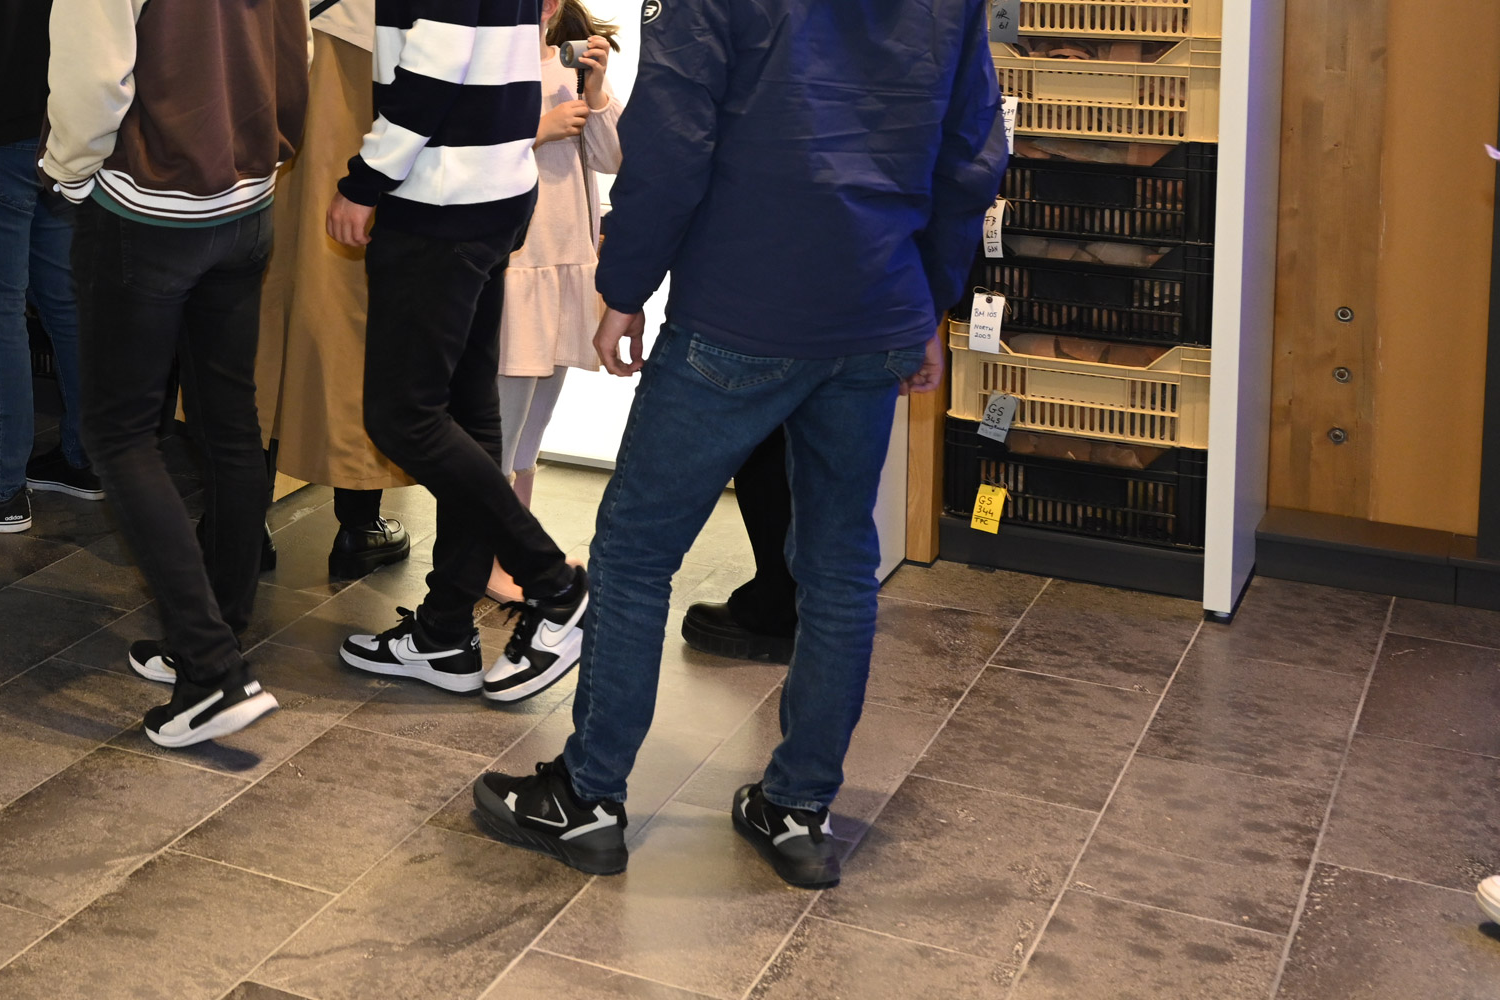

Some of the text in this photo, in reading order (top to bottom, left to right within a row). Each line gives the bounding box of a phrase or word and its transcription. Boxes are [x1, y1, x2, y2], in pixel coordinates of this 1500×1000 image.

[988, 403, 1004, 416] GS
[985, 415, 1001, 425] 345
[978, 495, 993, 506] GS
[976, 505, 994, 517] 344
[974, 517, 989, 526] TPC
